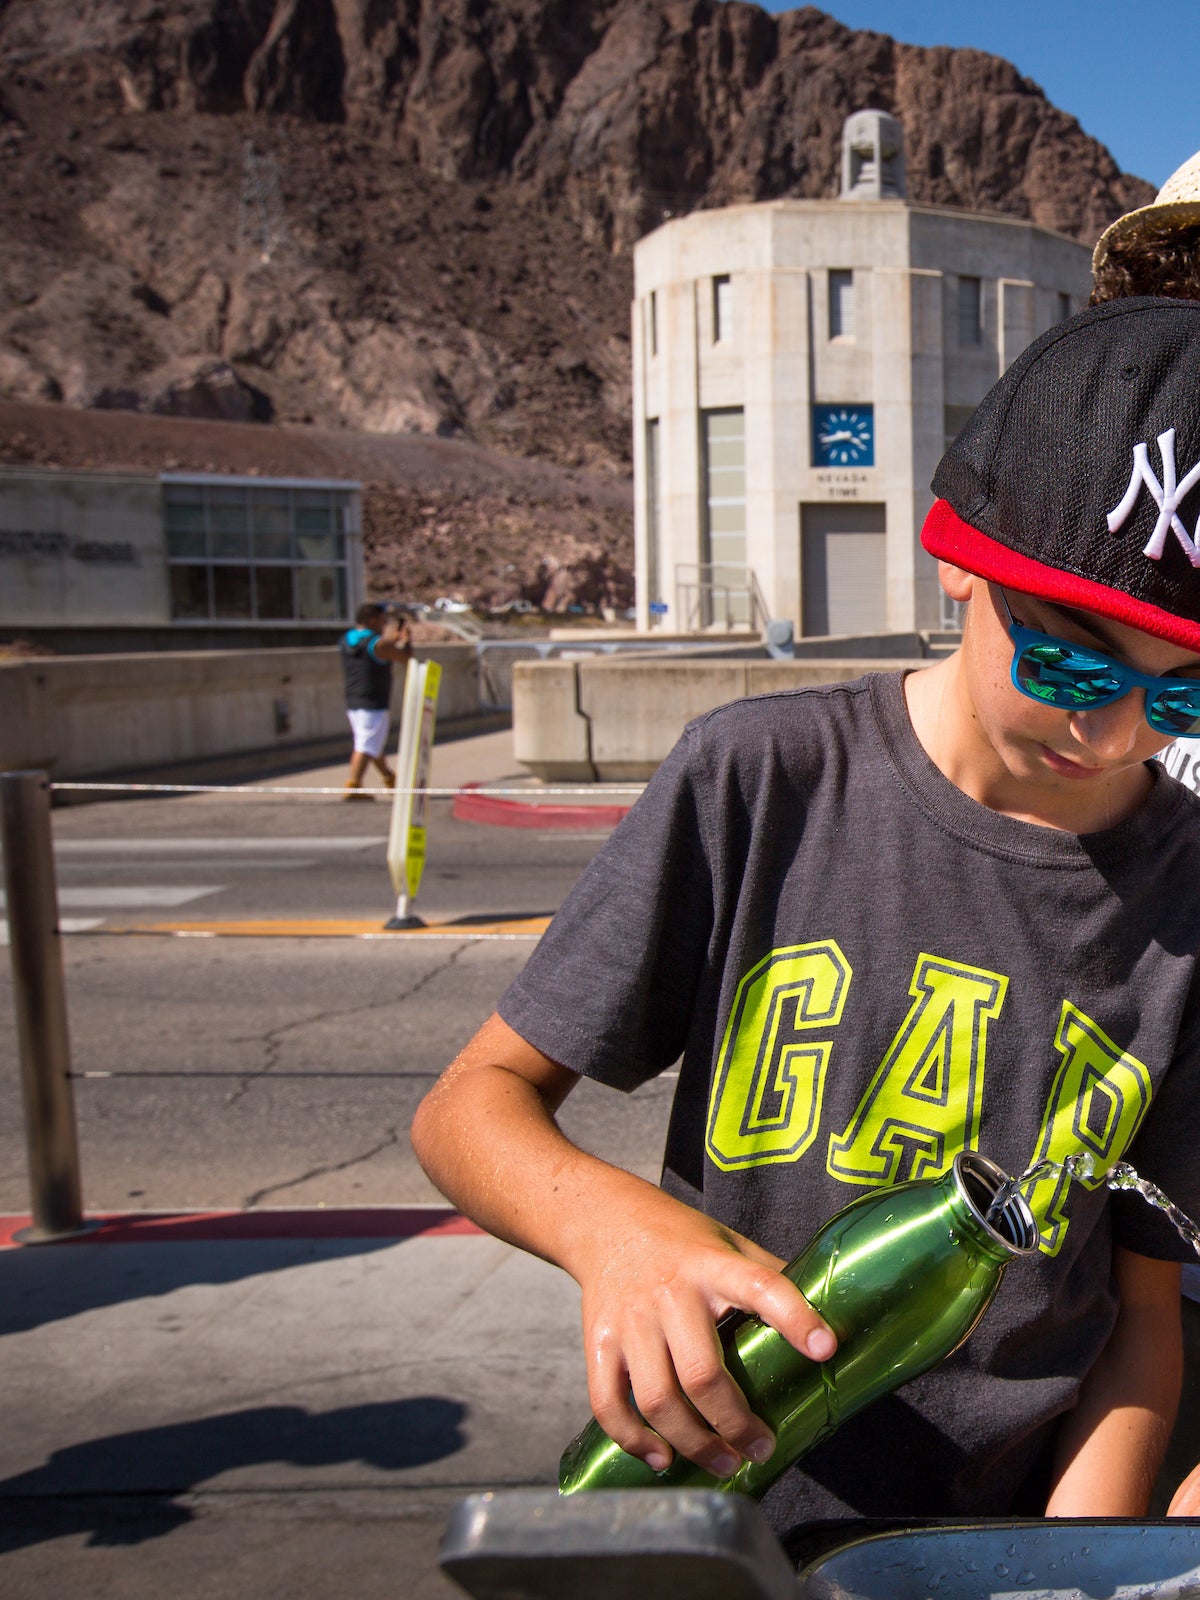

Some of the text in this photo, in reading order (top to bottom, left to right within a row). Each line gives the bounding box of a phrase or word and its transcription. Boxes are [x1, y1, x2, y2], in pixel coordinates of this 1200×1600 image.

[816, 473, 868, 483] NEVADA
[829, 487, 858, 497] TIME
[705, 938, 1153, 1258] GAP
